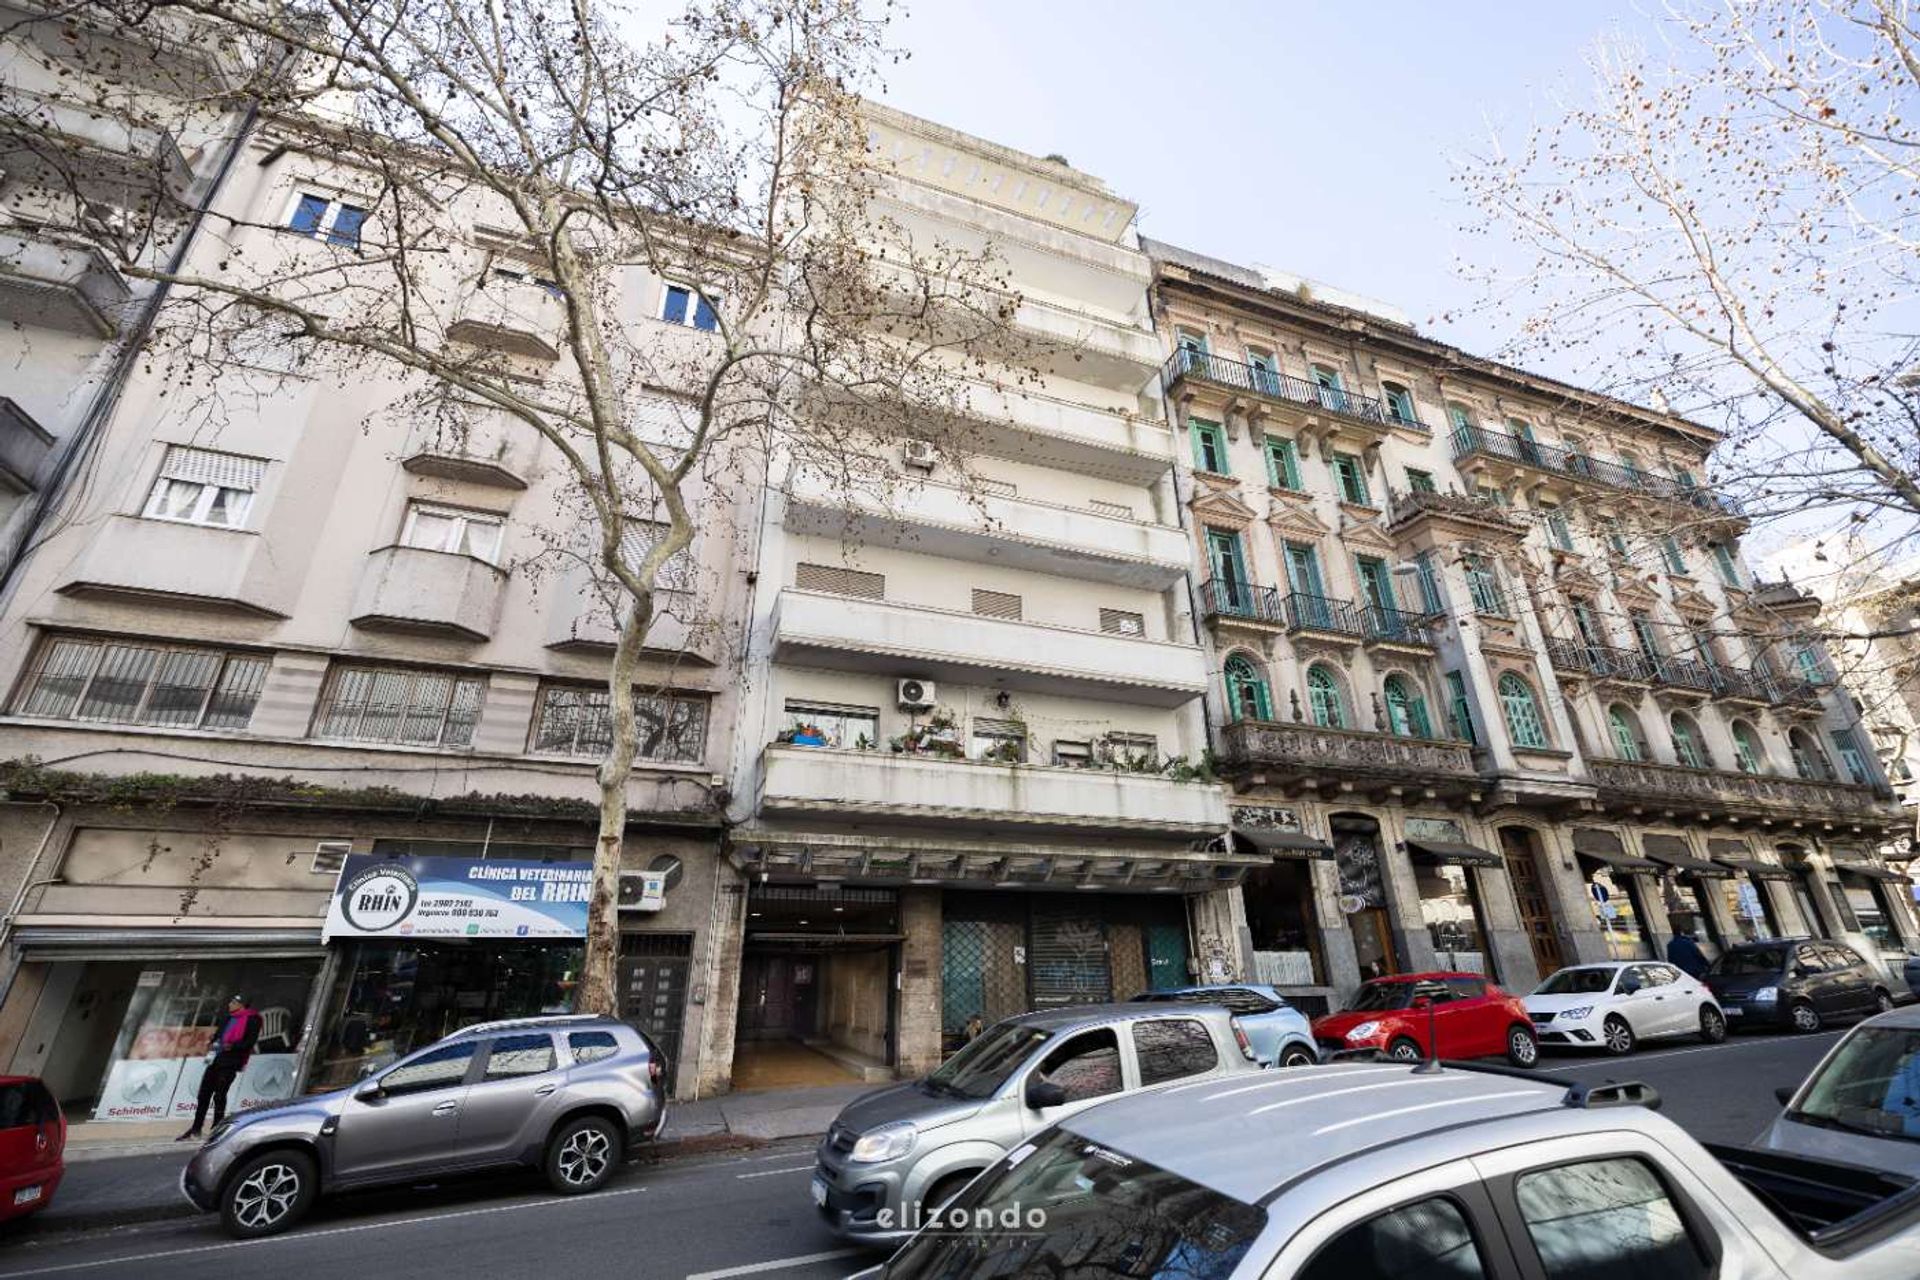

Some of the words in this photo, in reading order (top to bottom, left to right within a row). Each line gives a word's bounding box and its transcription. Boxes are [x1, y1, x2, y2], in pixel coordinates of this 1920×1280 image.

[469, 865, 517, 880] CLÍNICA
[511, 886, 537, 900] DEL
[541, 882, 593, 902] RHIN
[108, 1105, 162, 1117] Schindler
